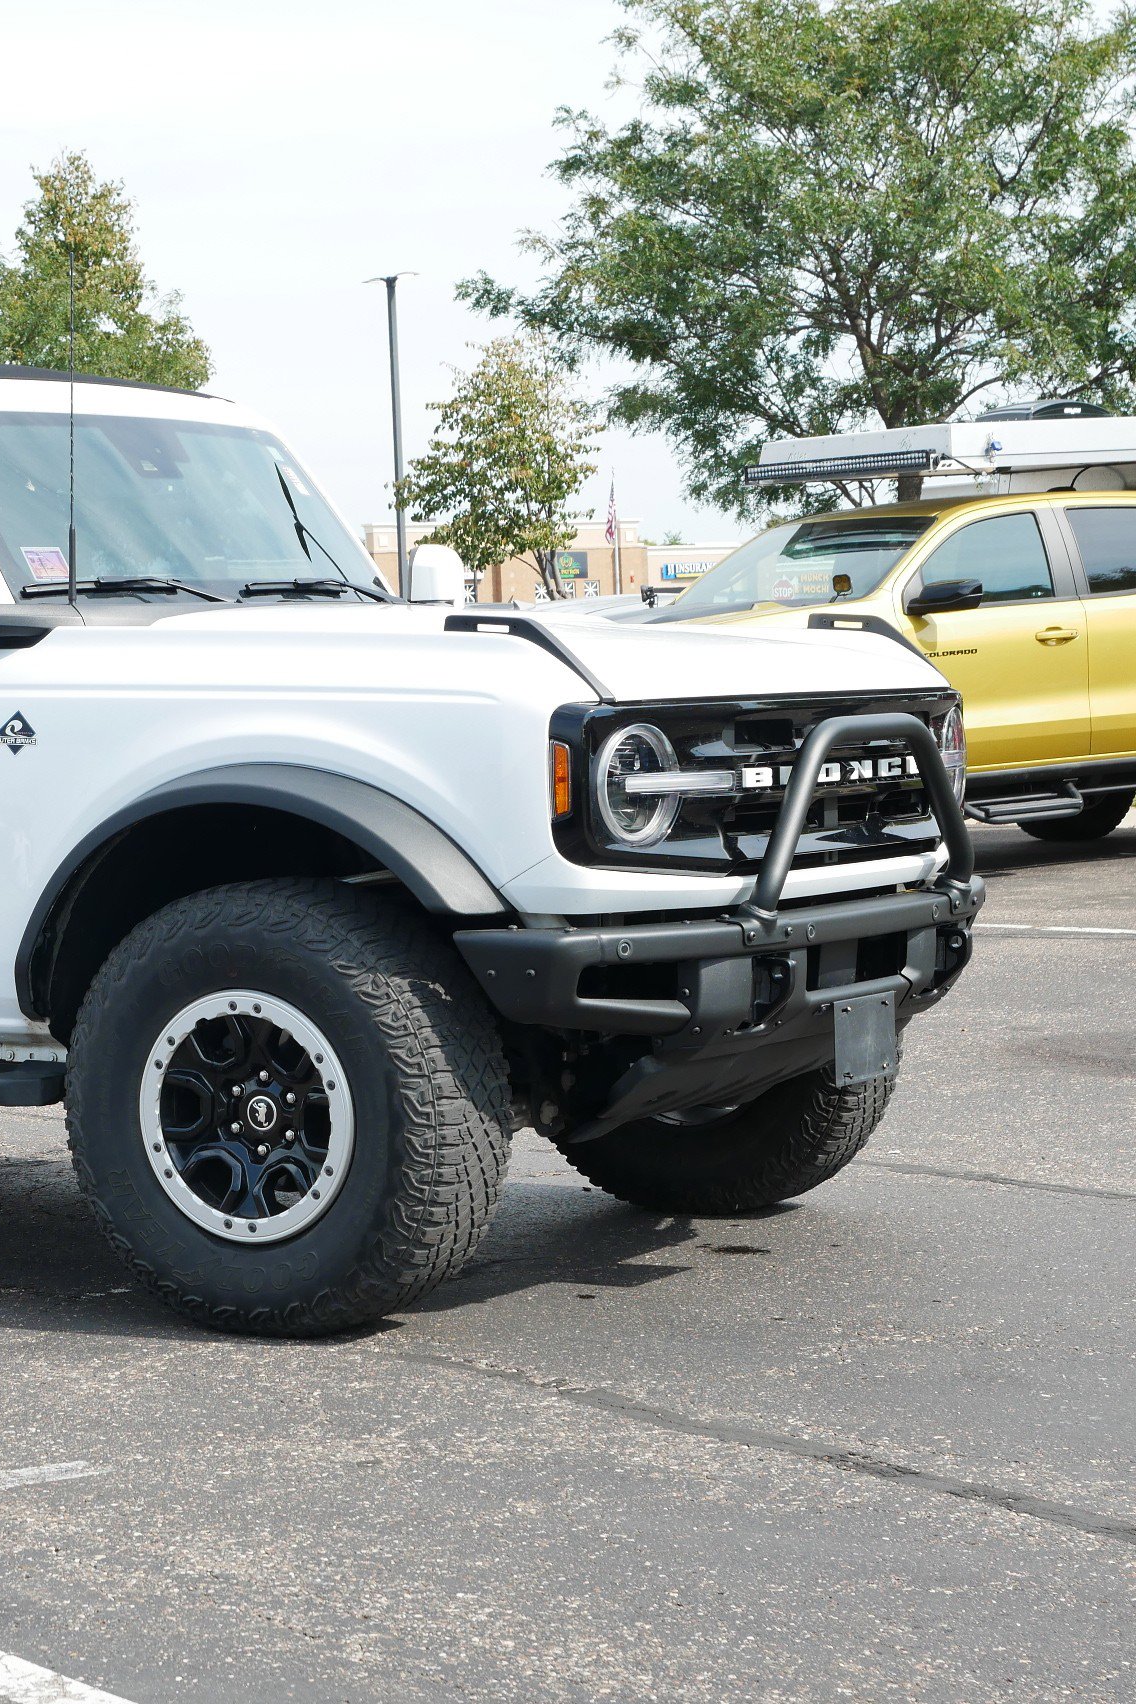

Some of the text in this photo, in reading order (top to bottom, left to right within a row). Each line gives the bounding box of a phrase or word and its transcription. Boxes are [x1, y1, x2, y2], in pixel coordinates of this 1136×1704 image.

[774, 587, 792, 597] STOP
[802, 585, 829, 593] MOCHI
[924, 648, 978, 658] COLORADO
